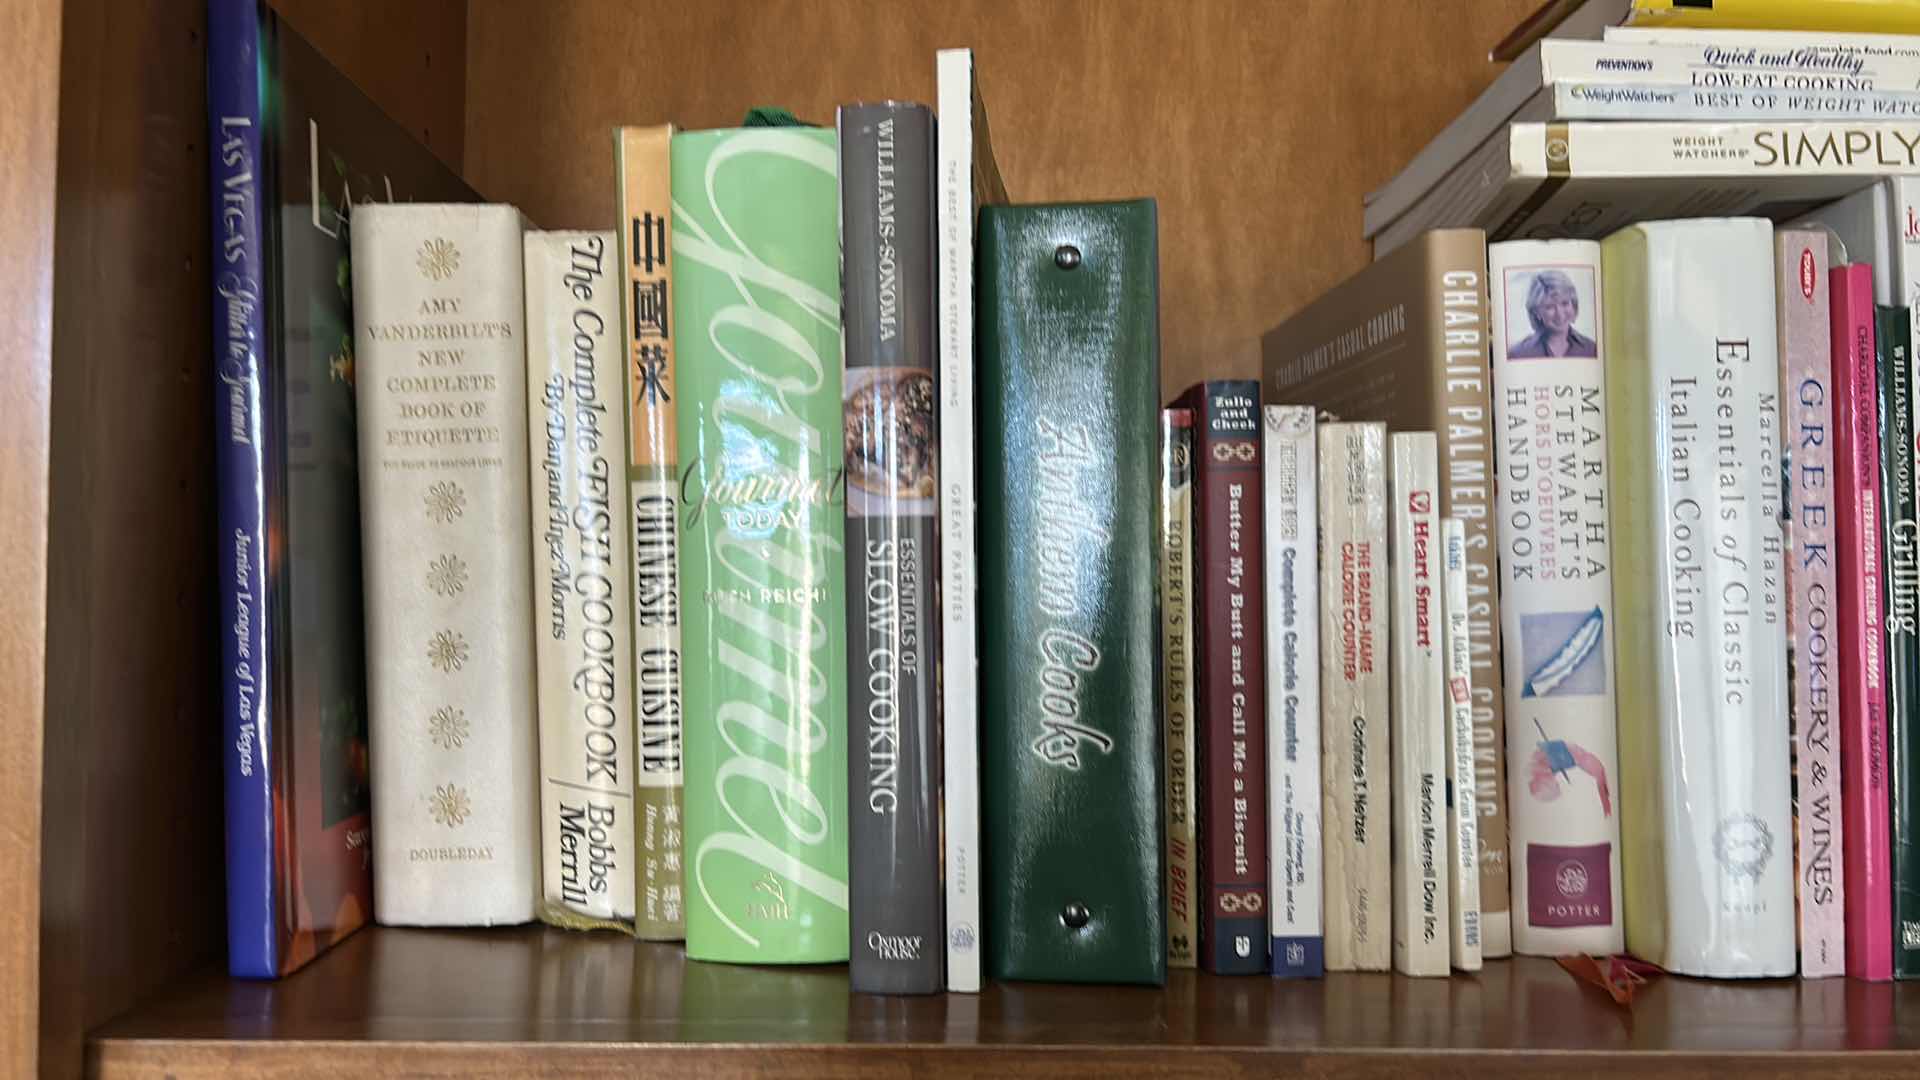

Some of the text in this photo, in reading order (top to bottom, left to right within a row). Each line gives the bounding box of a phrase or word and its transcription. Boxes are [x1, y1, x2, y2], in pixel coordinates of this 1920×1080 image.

[1582, 87, 1676, 104] WeightWatchers
[1595, 58, 1654, 71] PREVENTION'S
[1691, 71, 1874, 91] LOW-FAT COOKING
[1694, 92, 1743, 108] BEST
[1752, 94, 1778, 109] OF
[1788, 96, 1866, 113] WEIGHT
[1703, 45, 1864, 76] Quick and Healthy
[220, 115, 253, 167] LAS
[1672, 136, 1724, 147] WEIGHT
[1753, 130, 1920, 166] SIMPLY
[221, 170, 253, 264] VEGAS
[877, 118, 897, 342] WILLIAMS-SONOMA
[367, 321, 513, 341] VANDERBILT'S
[418, 298, 462, 315] AMY
[632, 211, 672, 407] 中國菜
[948, 159, 959, 408] THE BEST OF MARTHA STEWART LIVING
[1442, 270, 1482, 393] CHARLIE
[386, 374, 497, 393] COMPLETE
[400, 400, 487, 419] BOOK OF
[418, 350, 465, 367] NEW
[1220, 408, 1249, 419] and
[386, 427, 500, 447] ETIQUETTE
[1447, 405, 1487, 549] PALMER'S
[1507, 387, 1533, 581] HANDBOOK
[1534, 386, 1556, 581] HORS D'OEUVRES
[1554, 385, 1581, 580] STEWART'S
[1580, 386, 1607, 579] MARTHA
[1887, 345, 1920, 637] WILLIAMS-SONOMA Grilling
[541, 373, 573, 640] By Dan and Inez Morris
[564, 235, 619, 786] The Complete FISH COOKBOOK
[672, 130, 848, 947] Gourmet
[682, 458, 843, 530] Gourmet
[721, 510, 802, 529] TODAY
[1667, 376, 1702, 640] Italian Cooking
[1713, 337, 1750, 706] Essentials of Classic
[1759, 392, 1781, 625] Marcella Hazan
[1862, 489, 1876, 573] INTERNATIONAL
[899, 538, 917, 676] ESSENTIALS OF
[950, 483, 964, 623] GREAT PARTIES
[1032, 418, 1115, 771] Anthem Cooks
[1281, 546, 1298, 628] Complete
[1359, 540, 1373, 674] THE BRAND-NAME
[1414, 520, 1432, 647] Heart Smart
[1864, 575, 1878, 625] GRILLING
[233, 527, 256, 777] Junior League of Las Vegas
[636, 497, 681, 772] CHINESE CUISINE
[1282, 631, 1300, 691] Calorie
[1342, 541, 1356, 682] CALORIE COUNTER
[1452, 613, 1466, 632] Dr.
[1800, 378, 1833, 907] GREEK COOKERY & WINES
[1866, 628, 1879, 689] COOKBOOK
[866, 538, 898, 815] SLOW COOKING
[1168, 520, 1188, 923] ROBERT'S RULES OF ORDER IN BRIEF
[1227, 483, 1249, 876] Butter My Butt and Call Me a Biscuit
[1284, 694, 1301, 763] Counter
[1353, 715, 1368, 845] Corinne T. Netzer
[409, 847, 494, 862] DOUBLEDAY
[559, 802, 590, 905] Merrill
[587, 801, 617, 894] Bobbs
[956, 845, 967, 895] POTTER
[1421, 773, 1437, 945] Marion Merrell Dow Inc.
[1547, 904, 1601, 917] POTTER
